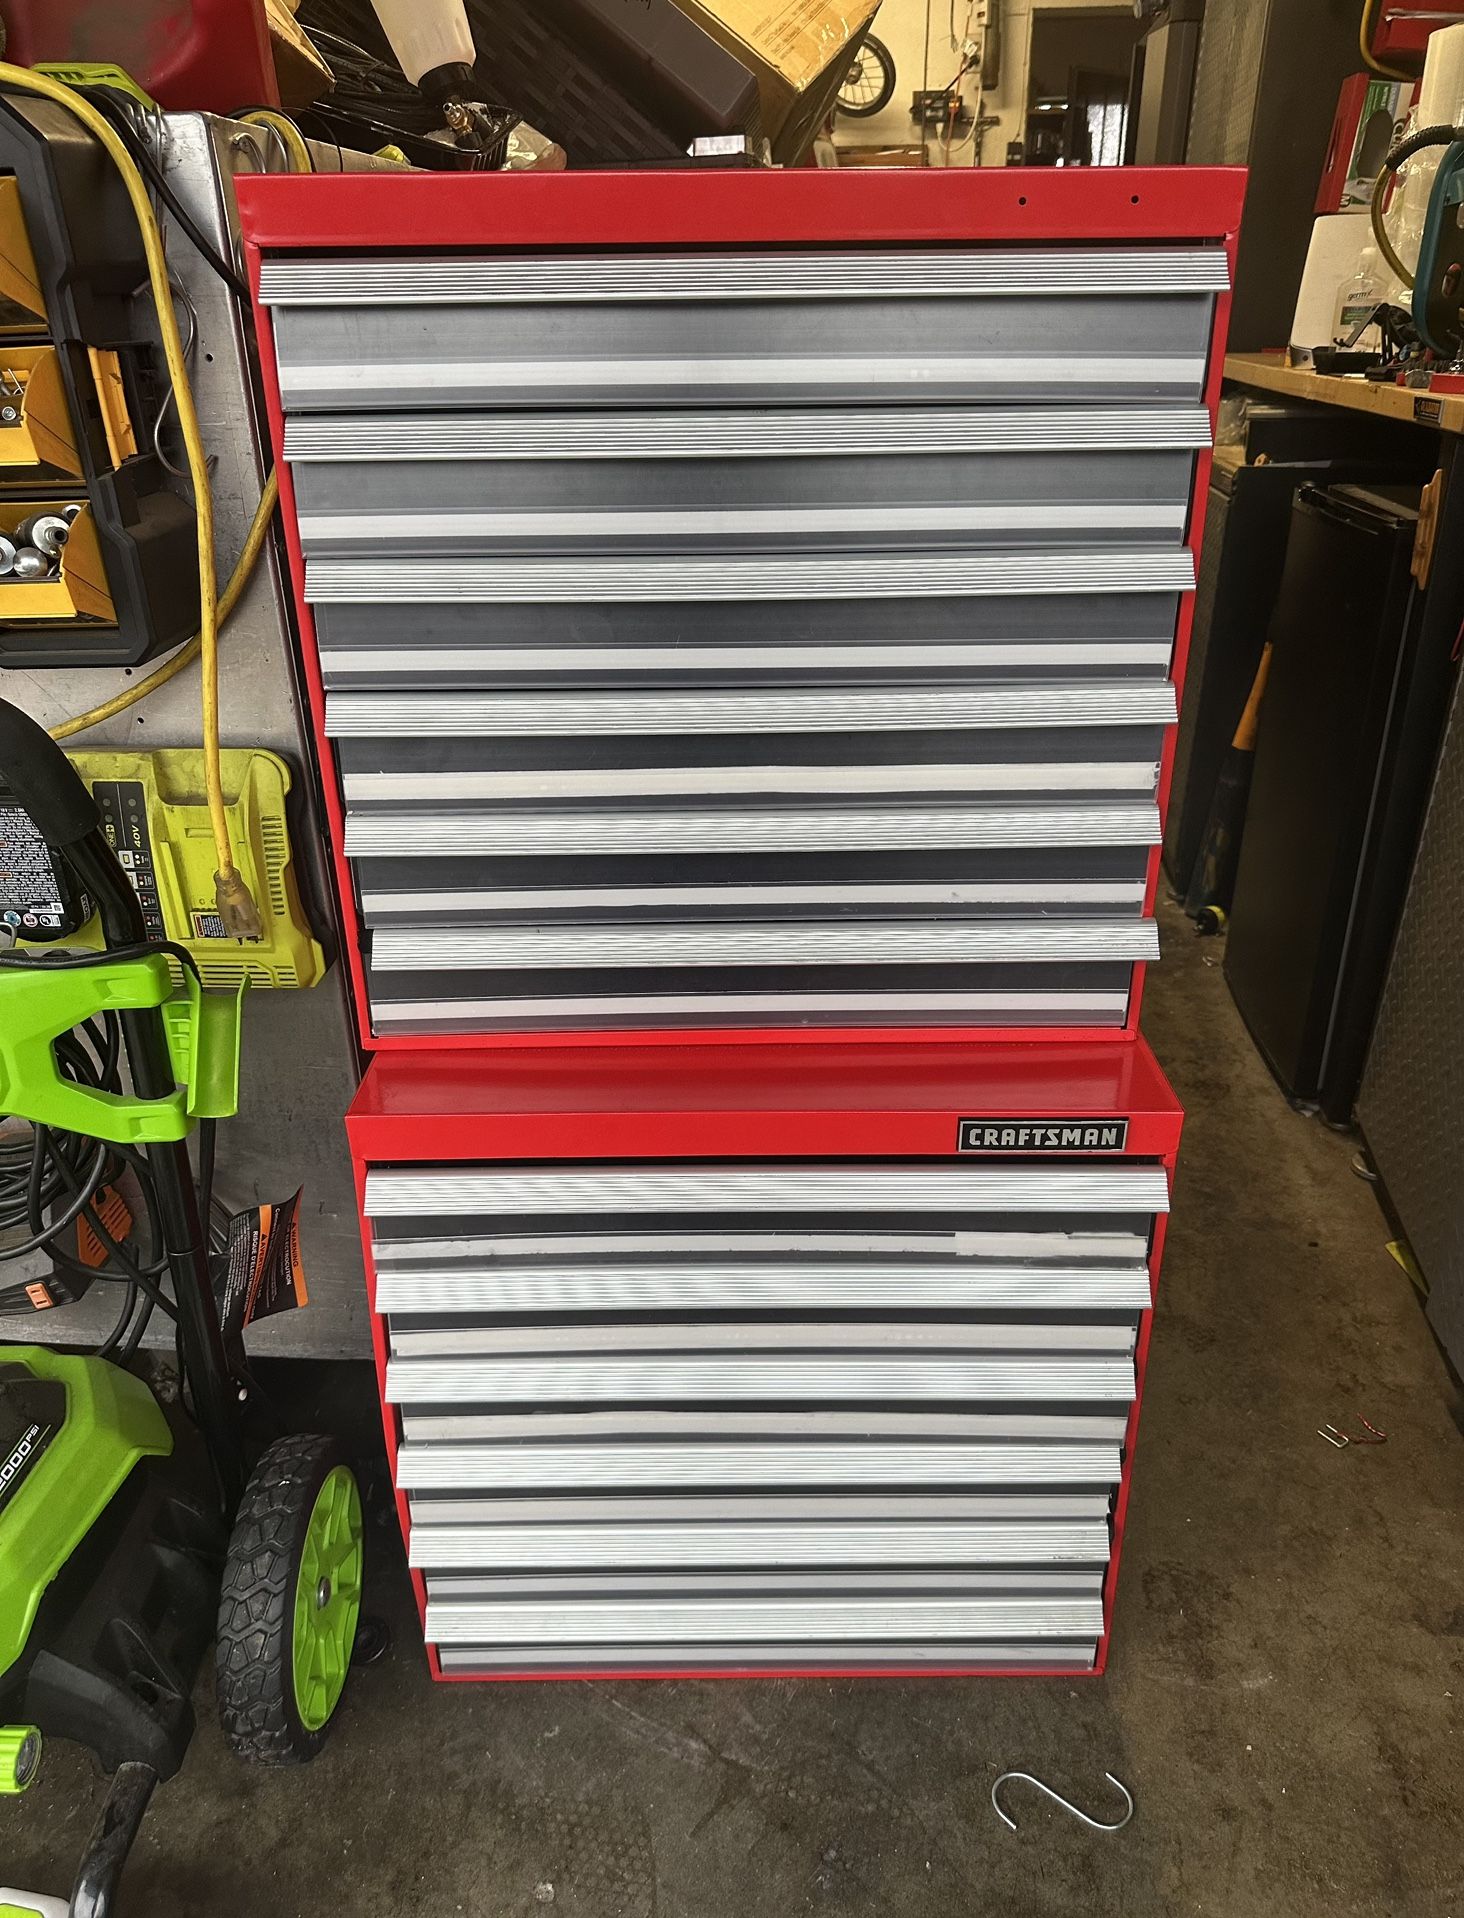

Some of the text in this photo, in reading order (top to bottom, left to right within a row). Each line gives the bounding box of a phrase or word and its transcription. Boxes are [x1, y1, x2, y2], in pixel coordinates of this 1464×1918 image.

[131, 824, 141, 848] 40V
[968, 1127, 1118, 1146] CRAFTSMAN
[251, 1230, 259, 1254] RISQUE
[291, 1230, 299, 1268] WARNING
[26, 1424, 39, 1442] PSI
